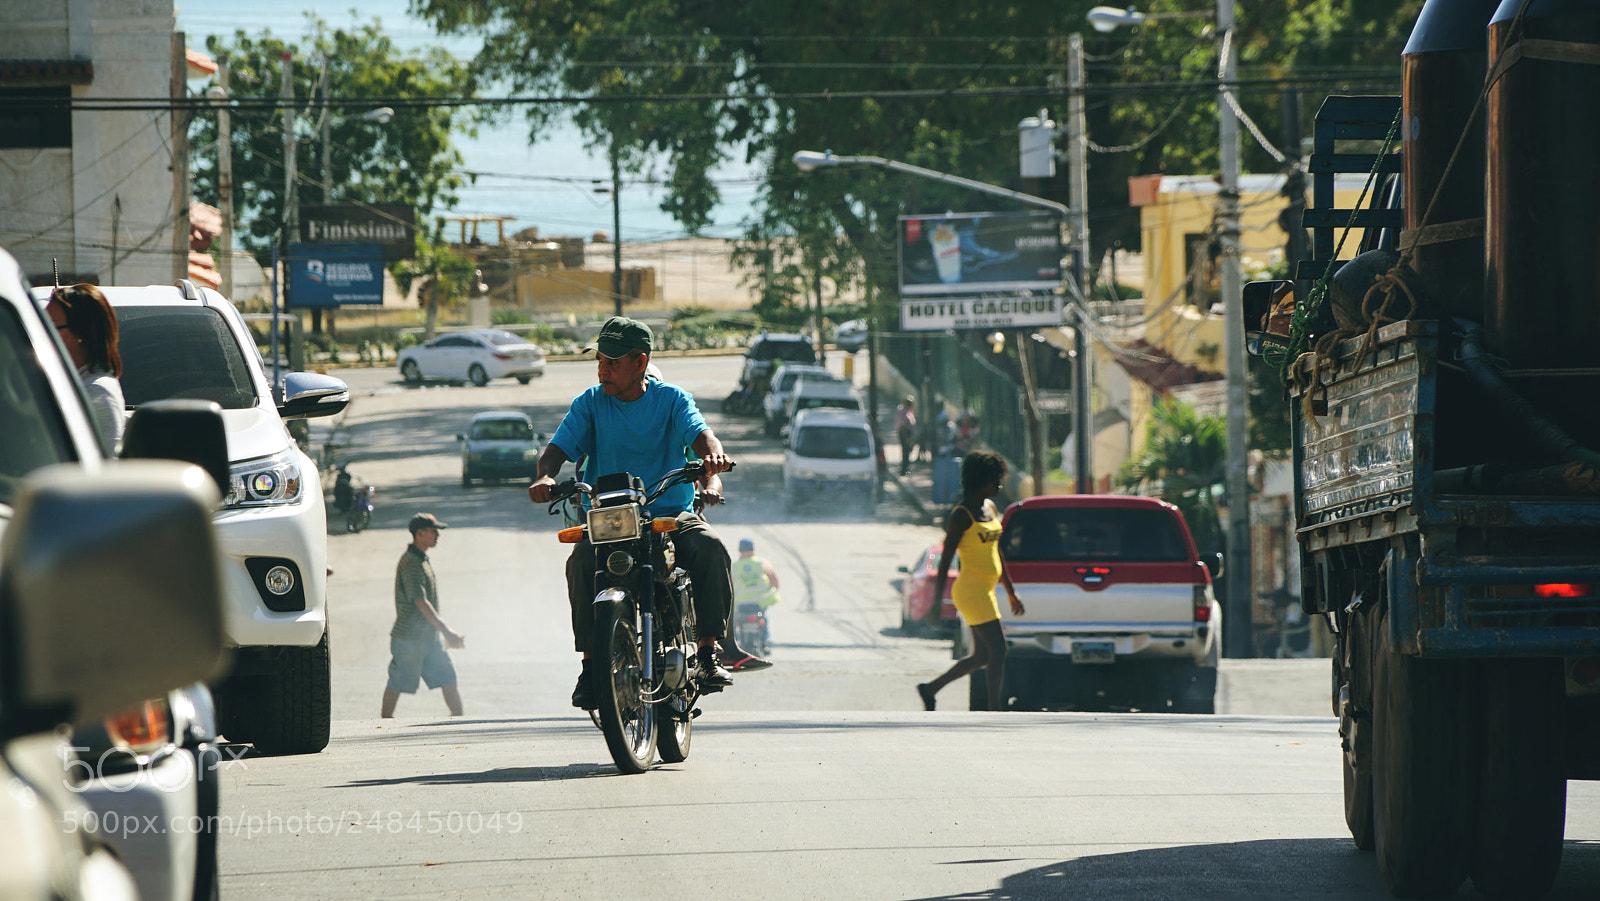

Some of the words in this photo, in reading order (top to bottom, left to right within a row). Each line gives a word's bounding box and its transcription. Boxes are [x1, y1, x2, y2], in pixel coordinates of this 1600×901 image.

[325, 263, 371, 273] SEGUROS
[909, 302, 966, 318] HOTEL
[972, 299, 1056, 316] CACIQUE
